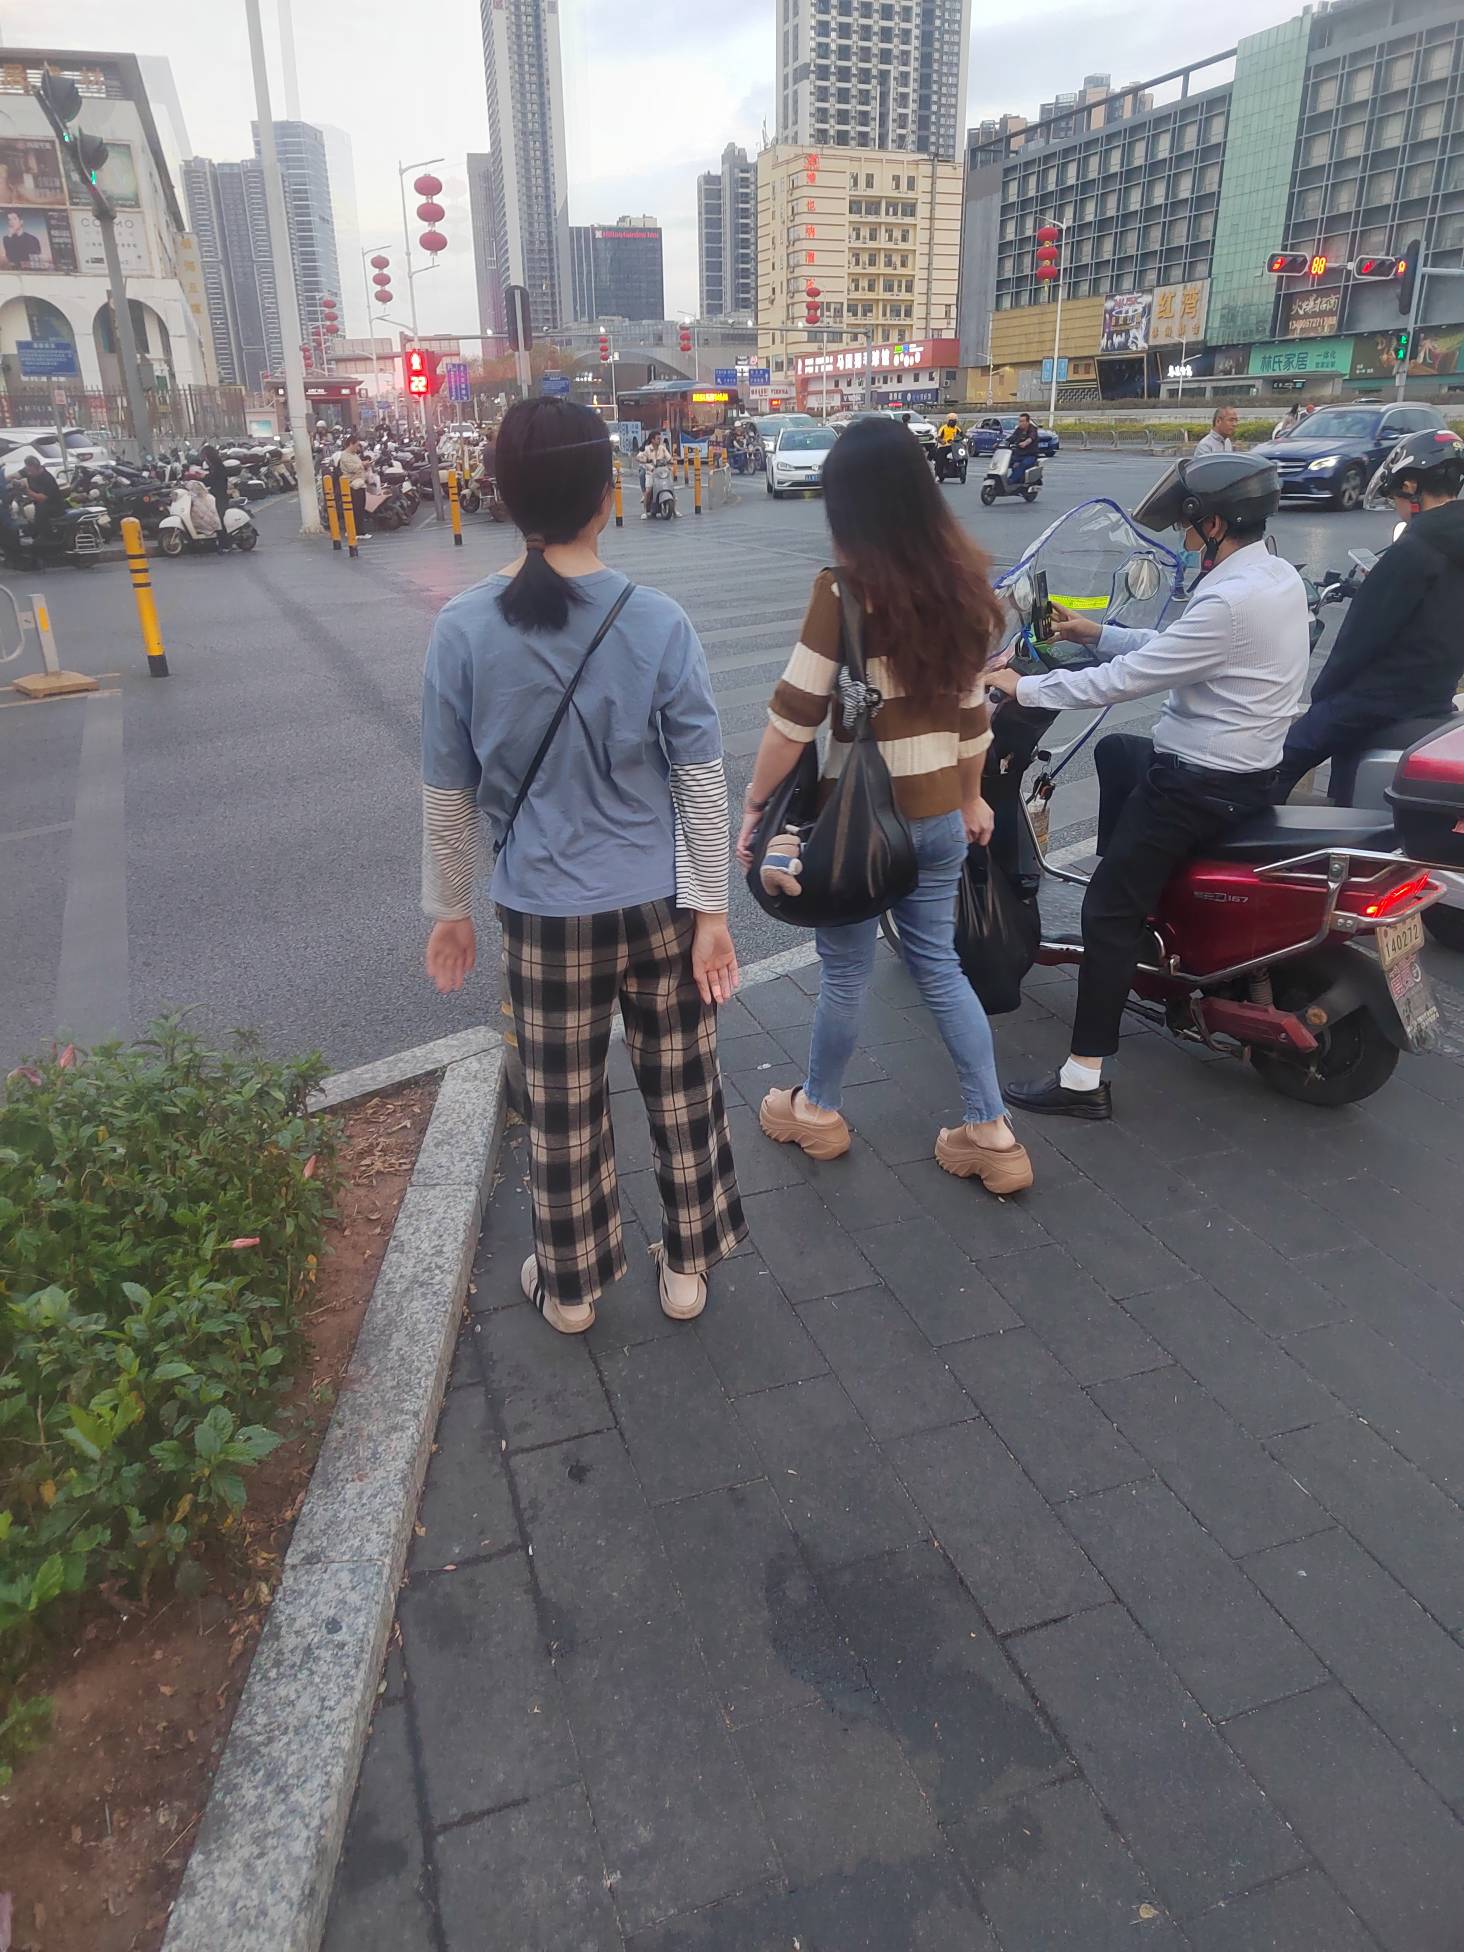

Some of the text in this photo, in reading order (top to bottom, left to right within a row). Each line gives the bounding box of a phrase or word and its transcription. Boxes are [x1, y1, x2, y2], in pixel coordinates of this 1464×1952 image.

[80, 217, 134, 230] COMO
[1157, 286, 1200, 319] 红湾
[1260, 352, 1308, 372] 林氏家居
[410, 376, 427, 393] 22
[1385, 924, 1419, 958] 140272
